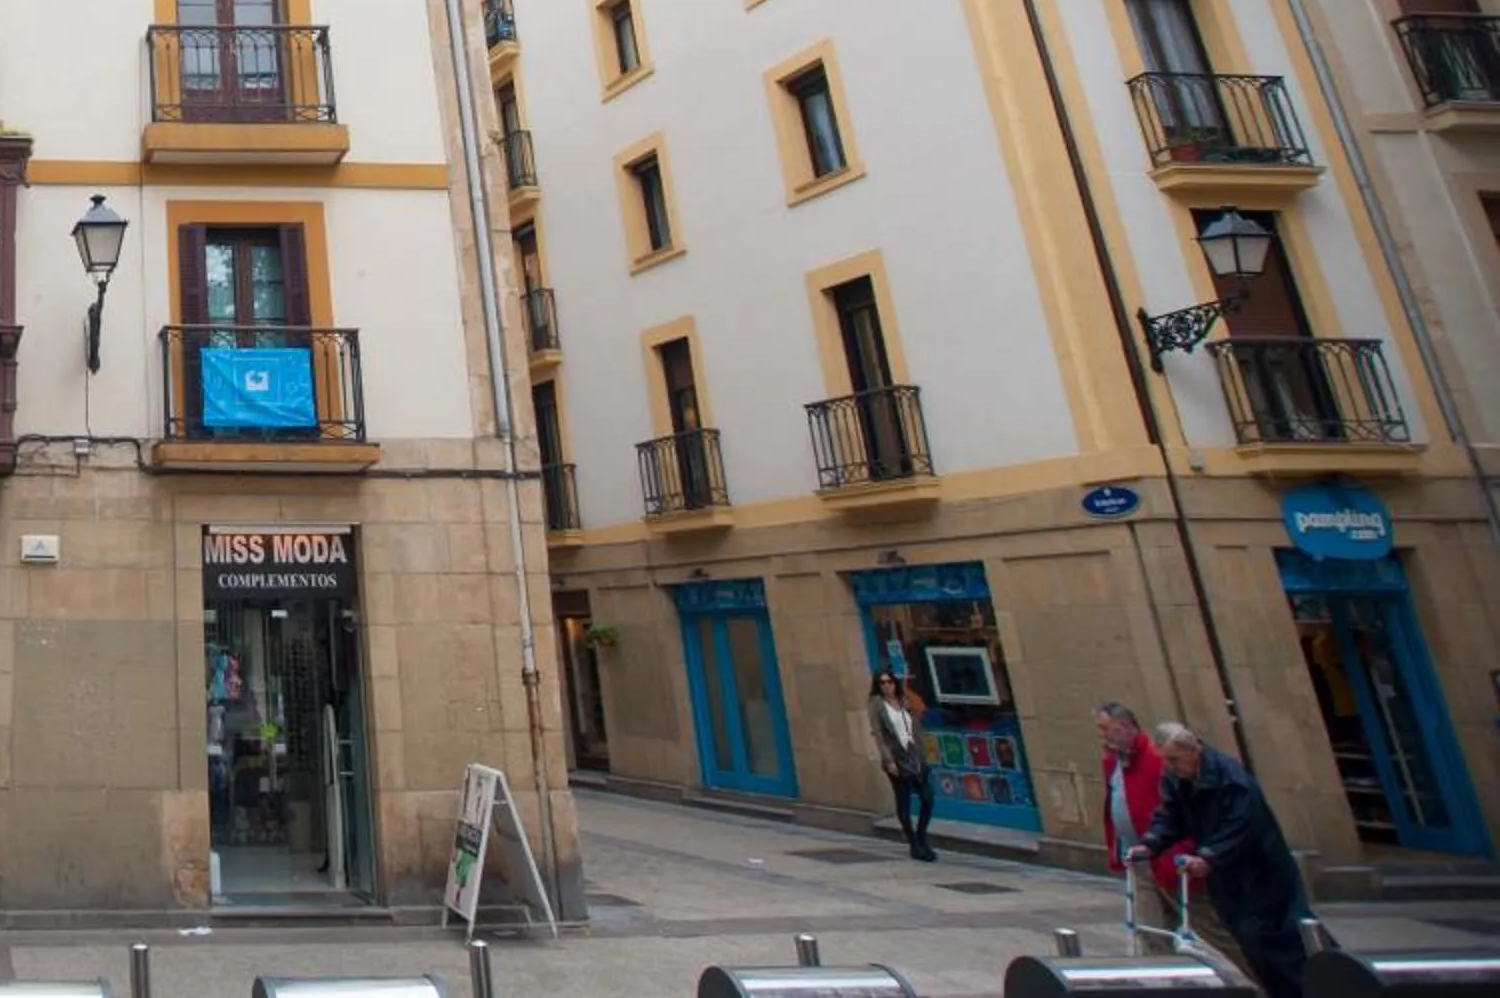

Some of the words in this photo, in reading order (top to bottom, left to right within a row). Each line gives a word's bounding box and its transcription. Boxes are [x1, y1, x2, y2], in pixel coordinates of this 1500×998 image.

[204, 535, 266, 564] MISS
[272, 535, 348, 564] MODA
[217, 573, 338, 589] COMPLEMENTOS
